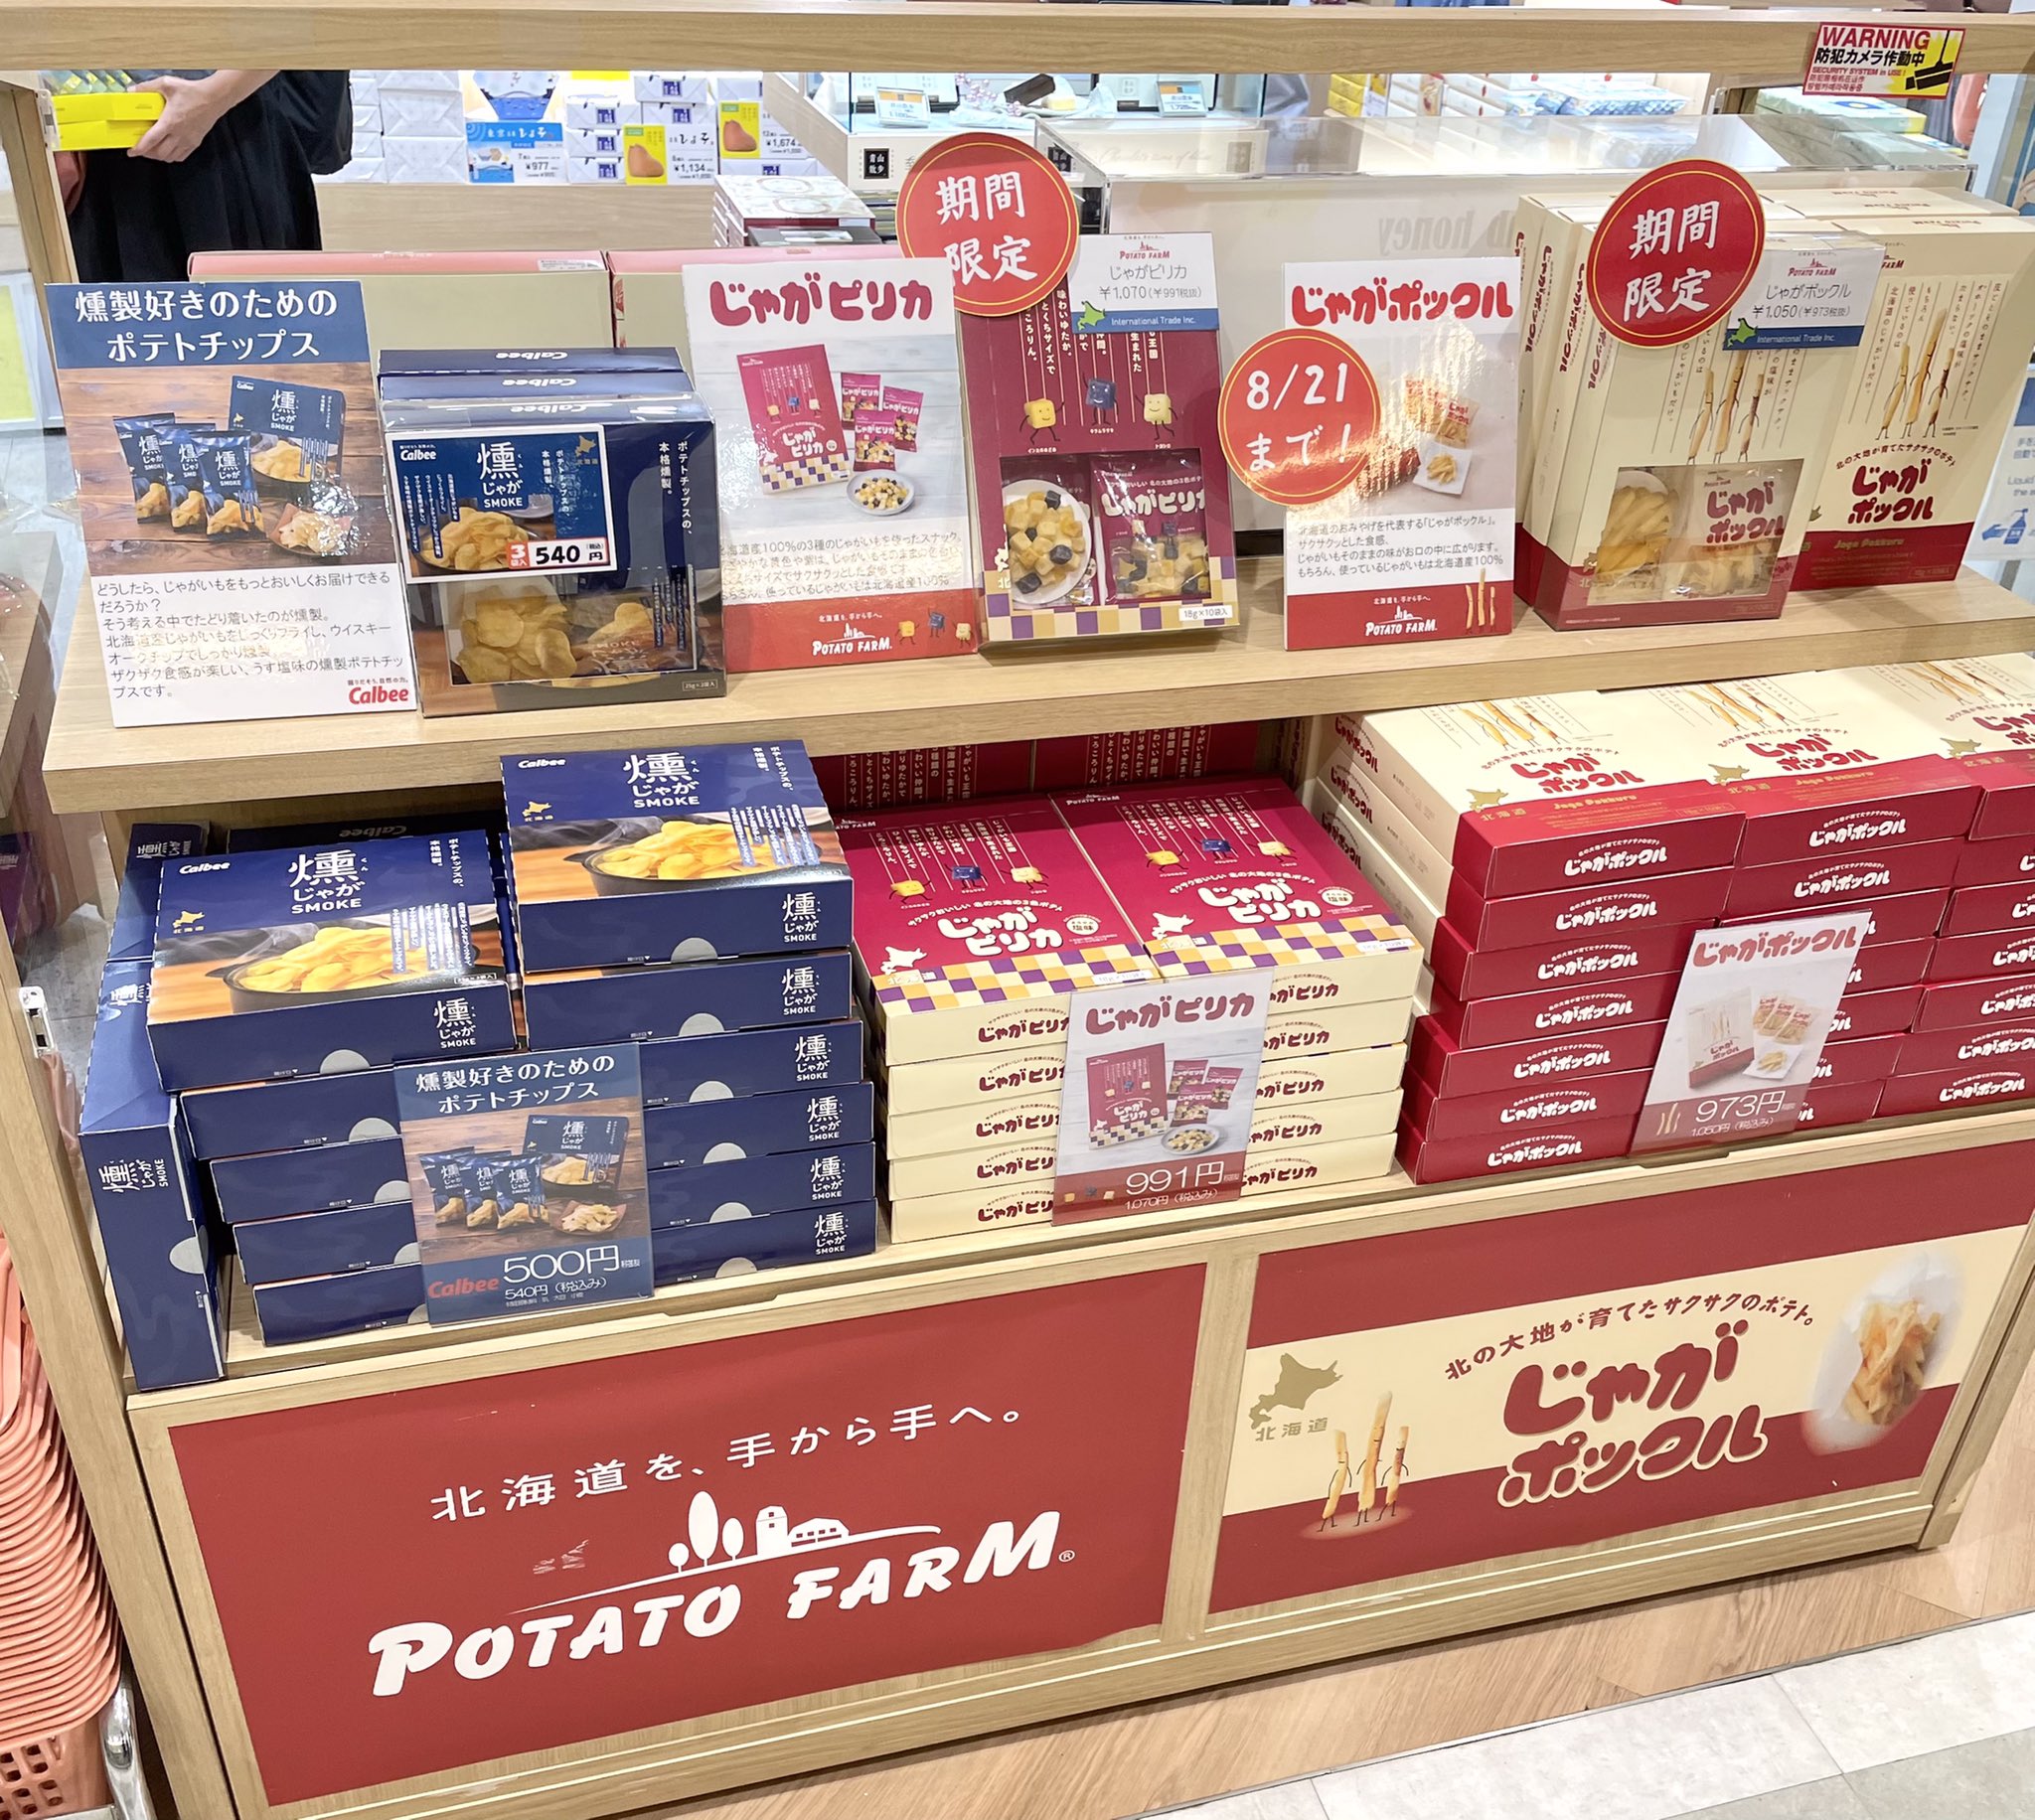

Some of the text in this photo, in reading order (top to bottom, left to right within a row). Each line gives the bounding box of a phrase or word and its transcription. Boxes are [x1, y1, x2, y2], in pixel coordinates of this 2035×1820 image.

[1823, 27, 1931, 50] WARNING
[1814, 48, 1925, 67] 防犯カメラ作動中
[526, 161, 548, 171] ¥977
[674, 164, 705, 173] ¥1,134
[936, 171, 1025, 226] 期間
[1630, 200, 1720, 259] 期間
[943, 234, 1038, 287] 限定
[1110, 264, 1186, 280] じゃがピリカ
[1789, 266, 1836, 277] POTATO FARM
[710, 272, 932, 326] じゃがピリカ
[1292, 277, 1513, 326] じゃがポックル
[1624, 267, 1714, 321] 限定
[1766, 283, 1851, 299] じゃがポックル
[75, 289, 337, 323] 燻製好きのための
[1112, 317, 1159, 326] International
[107, 329, 320, 362] ポテトチップス
[1757, 333, 1835, 343] International Trade Inc.
[503, 378, 576, 386] Calbee
[842, 387, 879, 396] じゃがピリカ
[1246, 363, 1348, 410] 8/21
[510, 404, 587, 413] Calbee
[883, 400, 919, 414] じゃがピリカ
[855, 424, 894, 435] じゃがピリカ
[400, 450, 436, 461] Calbee
[791, 439, 824, 457] ピリカ
[1246, 423, 1350, 471] まで！
[477, 442, 519, 480] 燻
[658, 442, 673, 495] 本格燻製。
[483, 480, 523, 496] じゃが
[678, 441, 692, 534] ポテトチップスの、
[1852, 459, 1932, 496] じゃが
[484, 498, 523, 508] SMOKE
[1848, 497, 1933, 524] ポックル
[1298, 517, 1495, 534] 北海道のおみやげを代表する「じゃがポックル」。
[1707, 516, 1785, 543] ポックル
[511, 544, 526, 558] 3
[536, 544, 580, 564] 540
[589, 551, 603, 560] 円
[1298, 541, 1498, 563] じゃがいもそのままの味がお口の中に広がります。
[1298, 555, 1502, 577] もちろん、使っているじゃがいもは北海道産100%
[97, 571, 390, 596] どうしたら、じゃがいもをもっとおいしくお届けできる
[100, 598, 161, 613] だろうか？
[103, 609, 328, 631] そう考える中でたどり着いたのが燻製。
[1365, 619, 1436, 636] POTATO FARM
[813, 637, 890, 657] POTATO FARM
[113, 685, 173, 698] プスです。
[349, 686, 408, 704] Calbee
[518, 758, 565, 768] Calbee
[623, 752, 690, 784] 燻
[1777, 749, 1879, 771] ポックル
[632, 781, 700, 797] じゃが
[1538, 770, 1644, 794] ポックル
[634, 796, 701, 808] SMOKE
[1809, 819, 1907, 847] じゃがポックル
[179, 861, 231, 874] Calbee
[287, 849, 359, 887] 燻
[448, 837, 465, 888] ポテトチップスの、
[1565, 846, 1667, 875] じゃがポックル
[295, 882, 366, 902] じゃが
[1198, 879, 1293, 907] じゃが
[1794, 869, 1890, 898] じゃがポックル
[291, 898, 362, 914] SMOKE
[782, 892, 816, 922] 燻
[1228, 900, 1321, 924] ピリカ
[1556, 900, 1657, 931] じゃがポックル
[785, 920, 818, 933] じゃが
[938, 907, 1037, 938] じゃが
[784, 933, 817, 943] SMOKE
[966, 928, 1062, 956] ピリカ
[1693, 926, 1856, 967] じゃがポックル
[1538, 952, 1639, 980] じゃがポックル
[781, 967, 815, 994] 燻
[783, 1005, 816, 1015] SMOKE
[784, 993, 817, 1005] じゃが
[433, 997, 476, 1028] 燻
[1086, 992, 1254, 1035] じゃがピリカ
[1535, 999, 1634, 1029] じゃがポックル
[439, 1026, 476, 1040] じゃが
[440, 1038, 476, 1048] SMOKE
[795, 1034, 827, 1062] 燻
[415, 1054, 615, 1093] 燻製好きのための
[797, 1060, 830, 1072] じゃが
[797, 1072, 829, 1081] SMOKE
[1514, 1050, 1611, 1079] じゃがポックル
[438, 1082, 599, 1115] ポテトチップス
[1940, 1078, 2025, 1103] じゃがポックル
[807, 1096, 839, 1124] 燻
[1119, 1110, 1148, 1124] ピリカ
[1500, 1097, 1598, 1124] じゃがポックル
[1696, 1091, 1786, 1123] 973円
[809, 1121, 841, 1133] じゃが
[809, 1133, 840, 1141] SMOKE
[1487, 1140, 1582, 1167] じゃがポックル
[98, 1161, 141, 1193] 燻
[159, 1158, 169, 1187] SMOKE
[810, 1156, 842, 1183] 燻
[1126, 1161, 1224, 1195] 991円
[812, 1191, 843, 1200] SMOKE
[813, 1180, 844, 1192] じゃが
[816, 1245, 846, 1255] SMOKE
[503, 1245, 619, 1284] 500円
[428, 1278, 499, 1298] Calbee
[505, 1286, 548, 1300] 540円
[555, 1278, 607, 1293] （税込み）
[1445, 1291, 1815, 1381] 北の大地が育てたサクサクのポテト。
[1502, 1317, 1750, 1438] じゃが
[1255, 1417, 1329, 1442] 北海道
[430, 1403, 1020, 1524] 北海道を、手から手へ。
[1496, 1404, 1770, 1509] ポックル
[367, 1510, 1061, 1698] POTATO FARM
